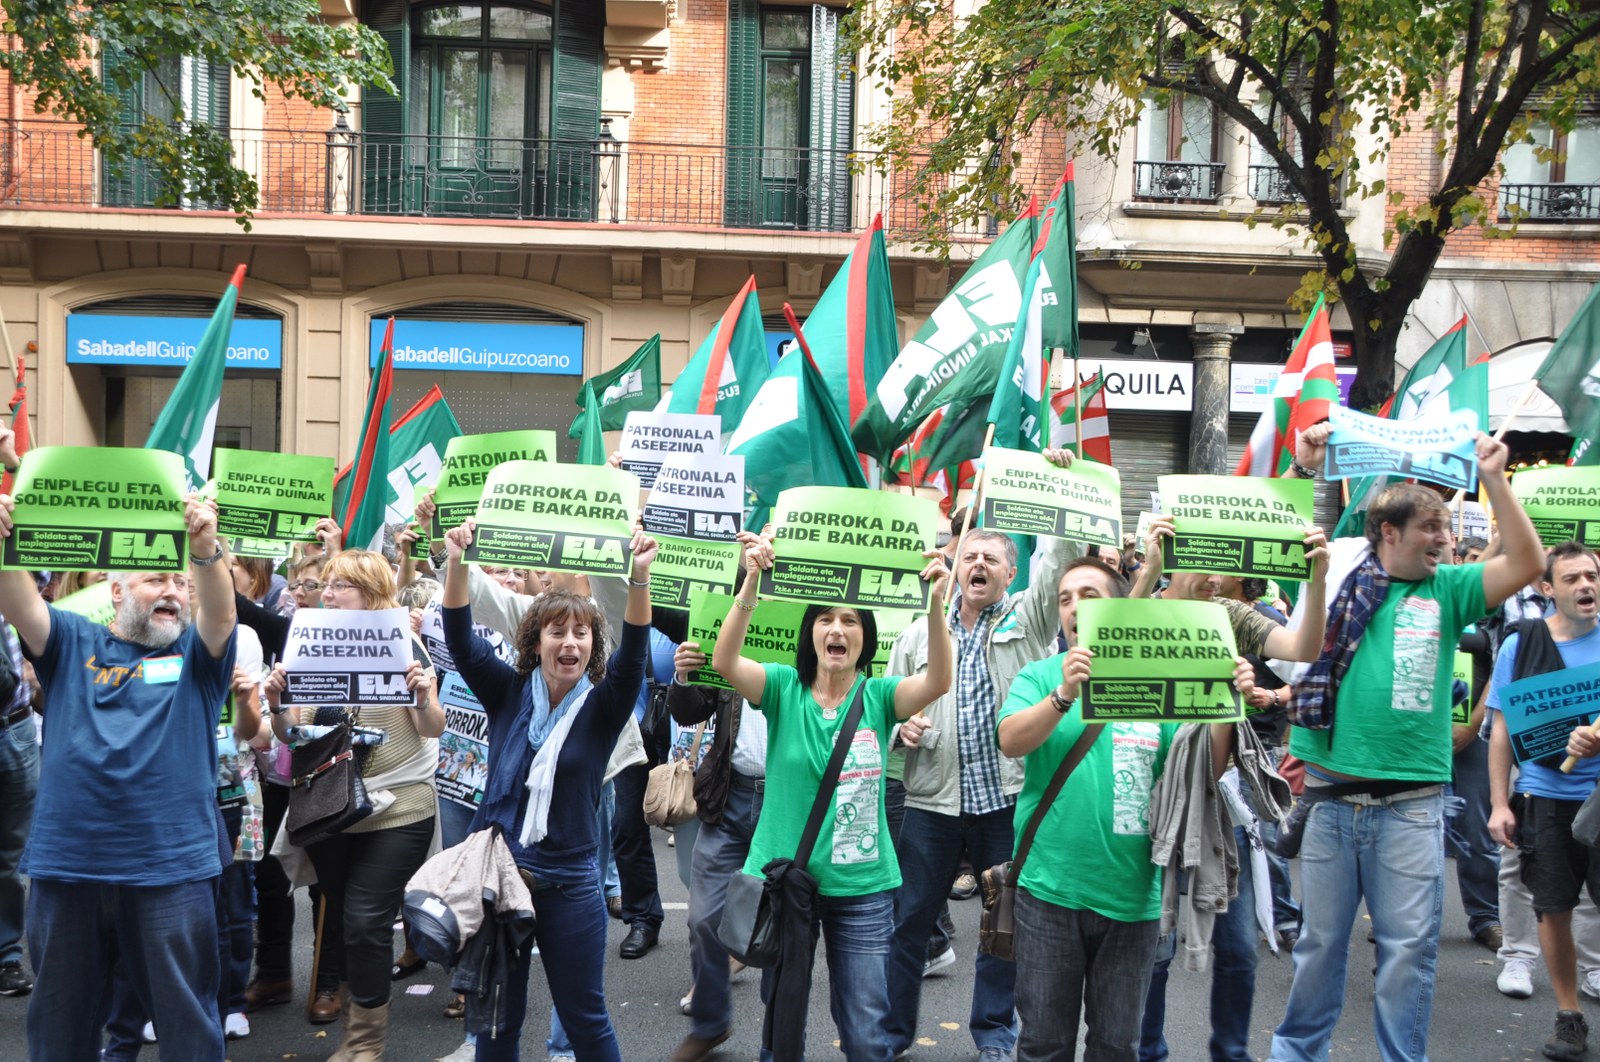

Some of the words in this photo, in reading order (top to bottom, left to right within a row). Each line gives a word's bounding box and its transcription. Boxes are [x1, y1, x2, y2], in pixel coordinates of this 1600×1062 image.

[78, 338, 269, 362] SabadellGuipoano
[1072, 372, 1186, 396] QUILA
[628, 426, 714, 440] PATRONALA
[631, 439, 704, 453] ASEEZINA
[228, 472, 285, 485] ENPLEGU
[290, 479, 313, 489] ETA
[448, 472, 488, 487] ASEE
[661, 468, 736, 483] ATRONALA
[1005, 469, 1069, 487] ENPLEGU
[1073, 482, 1099, 494] ETA
[32, 478, 120, 493] ENPLEGU
[127, 483, 162, 495] ETA
[217, 482, 271, 496] SOLDATA
[276, 489, 326, 501] DUINAK
[493, 483, 587, 501] BORROKA
[595, 491, 622, 505] DA
[655, 482, 725, 498] ASEEZINA
[991, 477, 1056, 493] SOLDATA
[1061, 488, 1113, 507] DUINAK
[15, 493, 101, 508] SOLDATA
[108, 498, 180, 512] DUINAK
[481, 498, 525, 512] BIDE
[532, 502, 629, 521] BAKARRA
[1006, 504, 1031, 513] Soldata
[1178, 494, 1267, 508] BORROKA
[1273, 501, 1297, 514] DA
[694, 513, 737, 533] ELA
[786, 511, 884, 531] BORROKA
[891, 520, 919, 535] DA
[1065, 511, 1115, 539] ELA
[1171, 507, 1213, 519] BIDE
[1219, 509, 1306, 527] BAKARRA
[34, 532, 67, 540] Soldata
[479, 539, 529, 549] enpleguaren
[531, 542, 549, 550] alde
[492, 532, 522, 540] Soldata
[775, 527, 820, 542] BIDE
[827, 531, 926, 552] BAKARRA
[1188, 539, 1215, 547] Soldata
[20, 541, 75, 550] enpleguaren
[111, 532, 178, 560] ELA
[561, 536, 624, 563] ELA
[665, 544, 692, 553] BAINO
[696, 548, 733, 559] GEHIAGO
[1176, 545, 1222, 555] enpleguaren
[653, 553, 724, 571] INDIKATUA
[1253, 541, 1307, 568] ELA
[561, 559, 584, 567] EUSKAL
[586, 560, 624, 570] SINDIKATUA
[788, 564, 818, 575] Soldata
[1253, 564, 1273, 572] EUSKAL
[1275, 566, 1306, 574] SINDIKATUA
[774, 572, 825, 583] enpleguaren
[827, 576, 845, 584] alde
[859, 569, 923, 598] ELA
[775, 585, 792, 593] Pelea
[814, 589, 839, 597] convenio
[858, 594, 881, 603] EUSKAL
[884, 596, 922, 606] SINDIKATUA
[292, 627, 403, 641] PATRONALA
[691, 627, 717, 641] ETA
[1098, 627, 1191, 641] BORROKA
[1198, 628, 1222, 641] DA
[298, 644, 394, 658] ASEEZINA
[1140, 646, 1232, 659] BAKARRA
[358, 674, 410, 695] ELA
[1509, 678, 1600, 706] PATRONA
[1174, 681, 1235, 708] ELA
[1525, 692, 1600, 716] ASEEZIN
